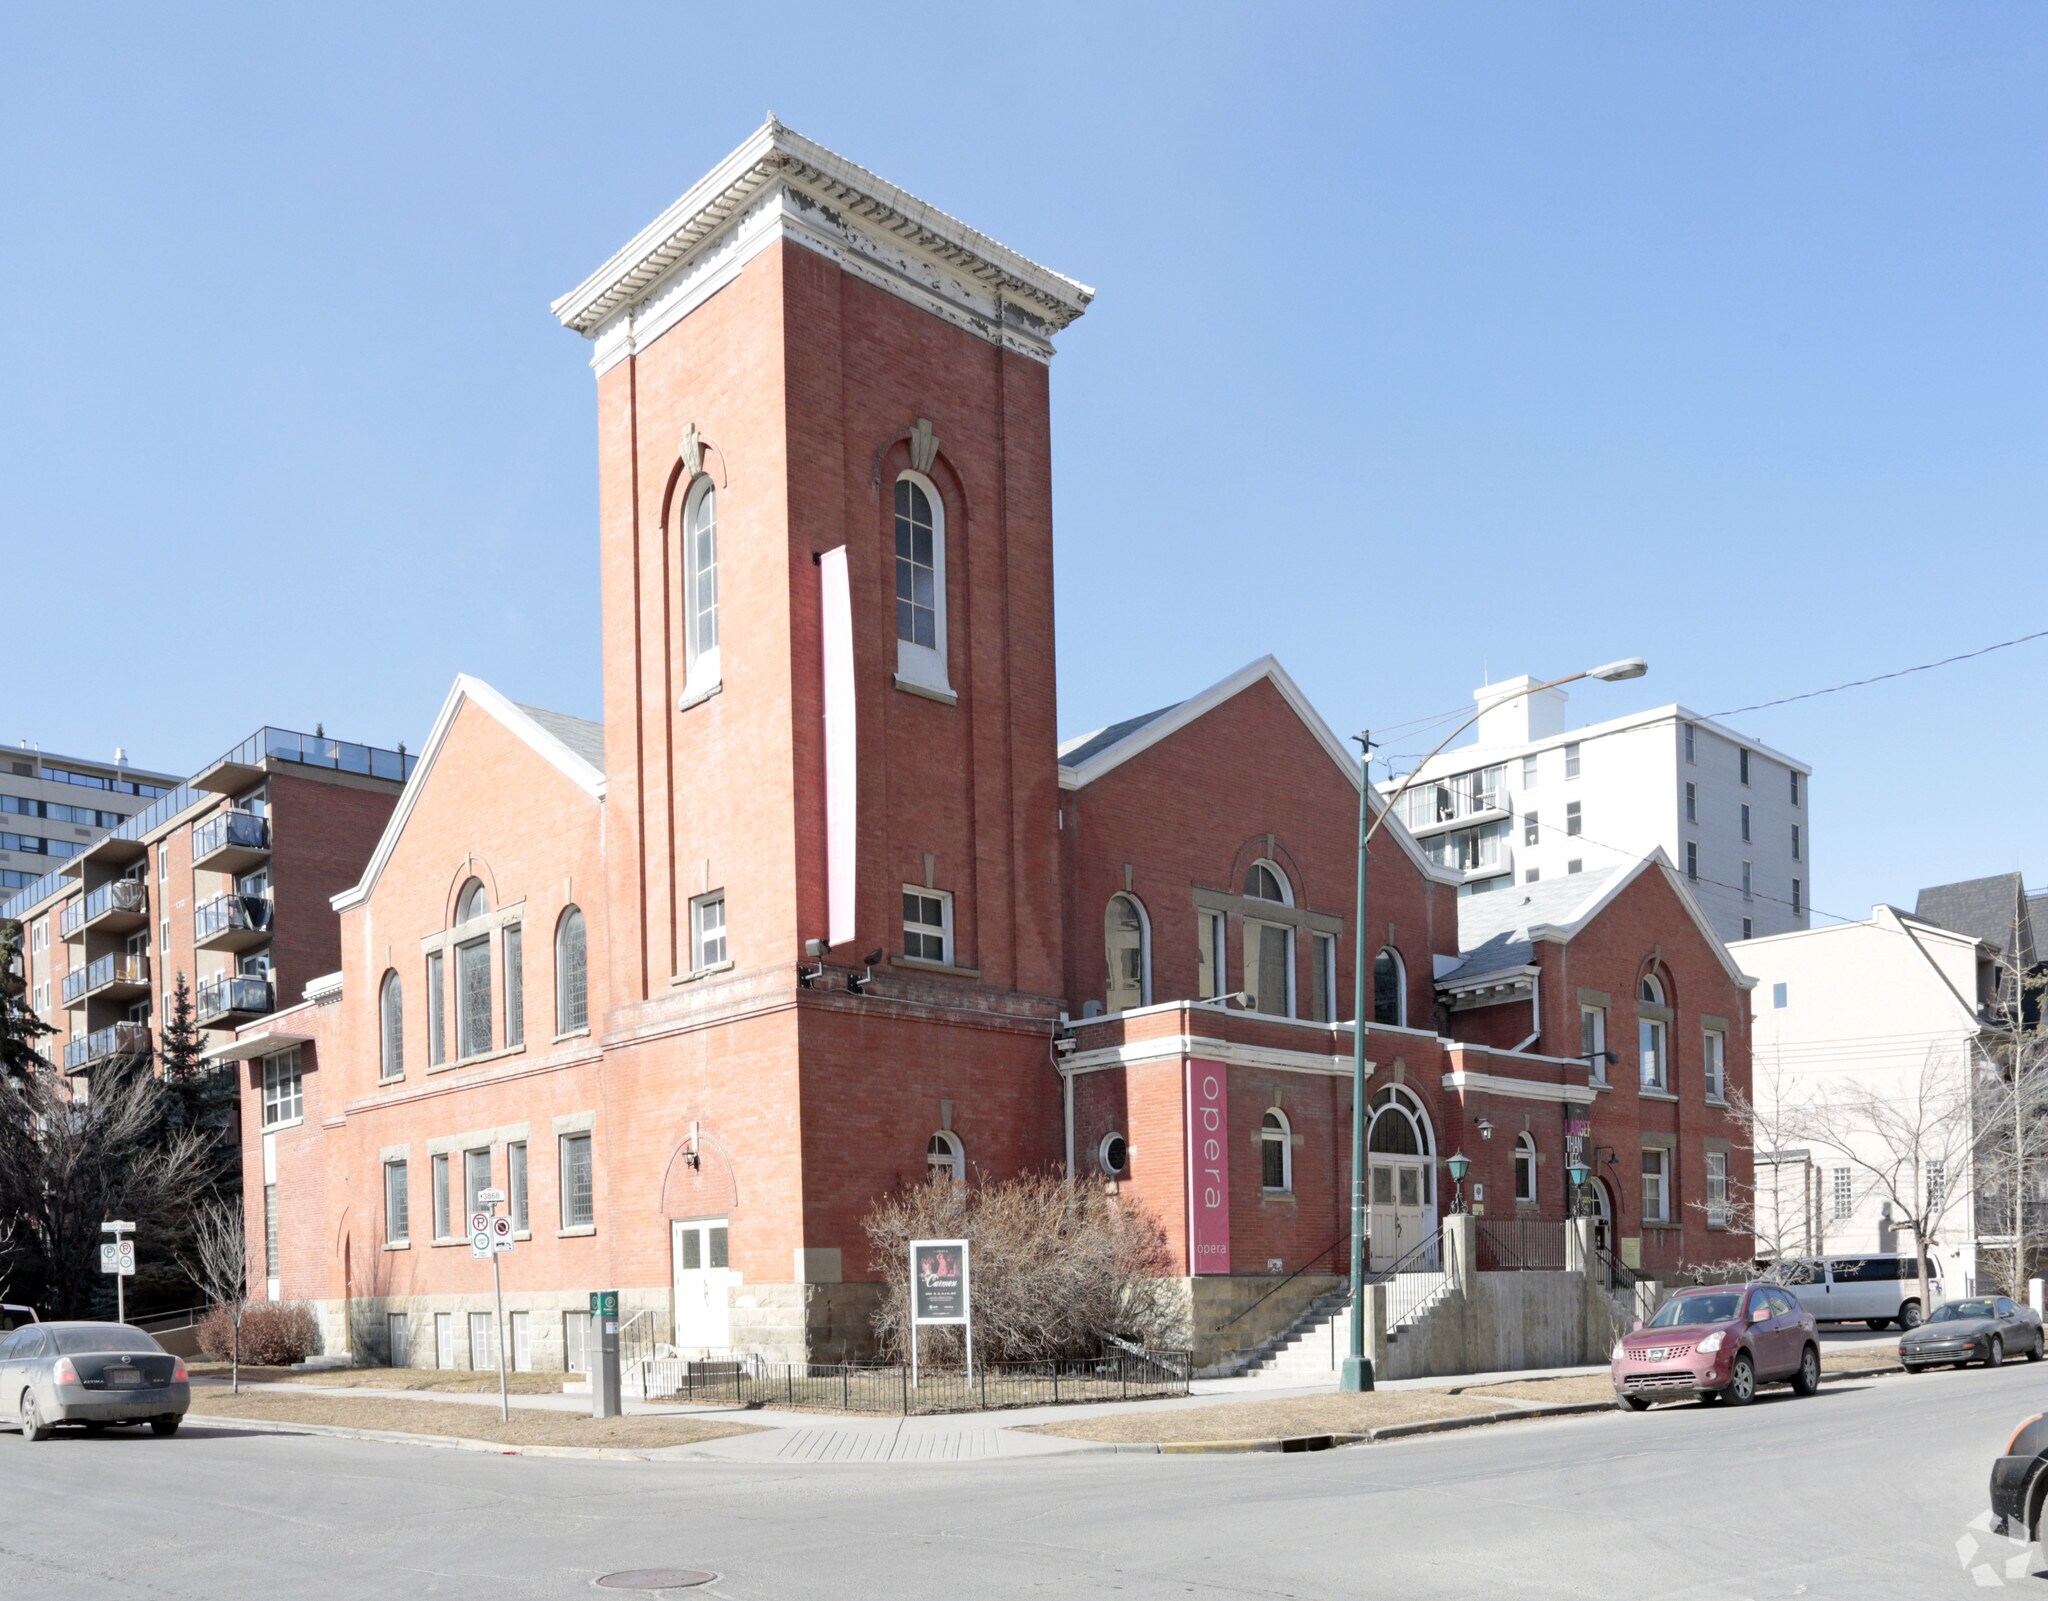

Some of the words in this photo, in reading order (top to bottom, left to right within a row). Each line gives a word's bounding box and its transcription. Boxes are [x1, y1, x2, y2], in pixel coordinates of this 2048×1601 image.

[1200, 1076, 1220, 1208] opera
[1565, 1136, 1583, 1153] THAN
[483, 1192, 500, 1200] 3868
[1197, 1244, 1227, 1256] opera
[926, 1273, 958, 1288] Carmen
